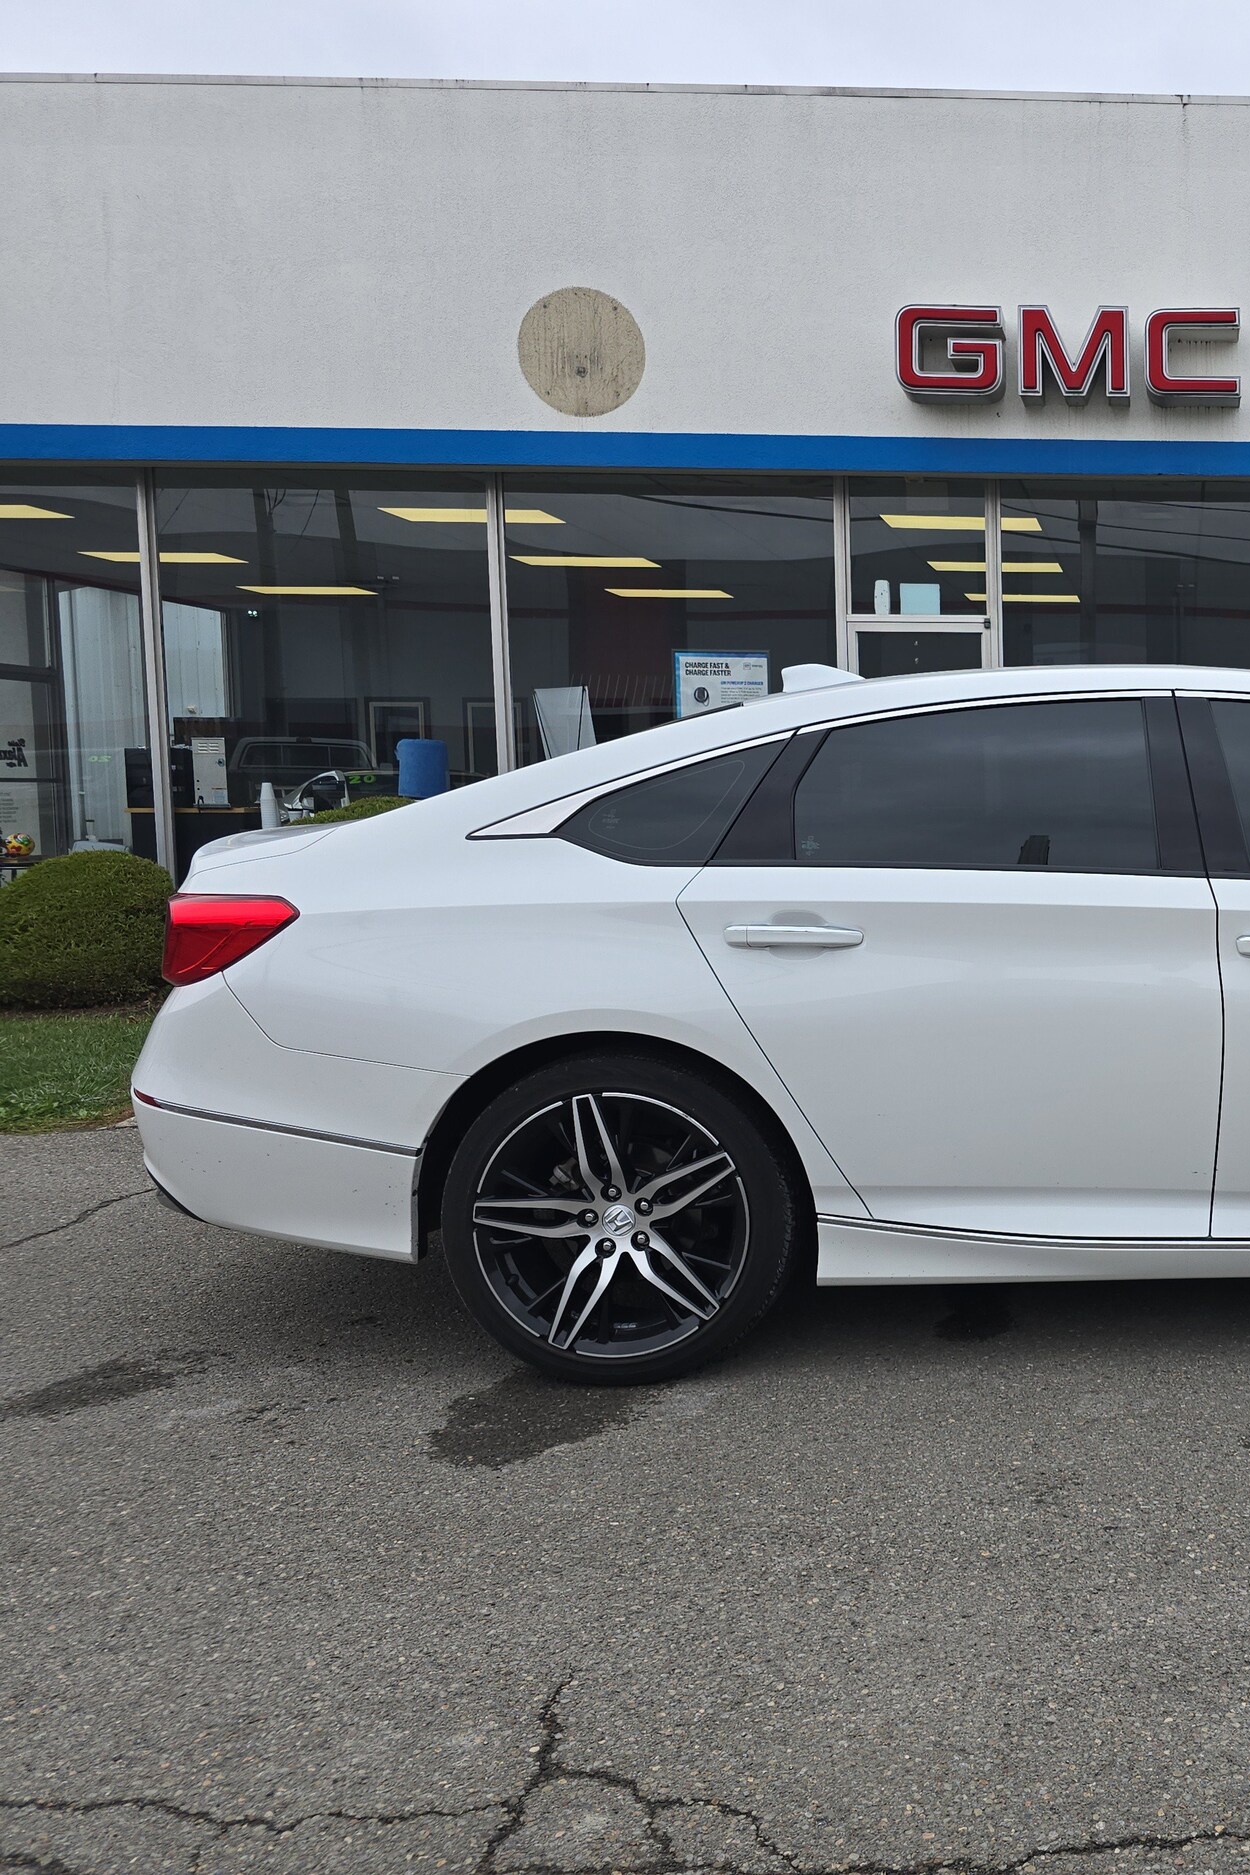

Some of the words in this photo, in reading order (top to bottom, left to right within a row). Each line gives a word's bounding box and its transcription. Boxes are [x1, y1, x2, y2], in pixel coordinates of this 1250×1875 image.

[895, 303, 1243, 406] GMC
[684, 661, 709, 669] CHARGE
[709, 662, 724, 670] FAST
[724, 662, 730, 670] &
[709, 669, 732, 677] FASTER
[349, 774, 377, 785] 20
